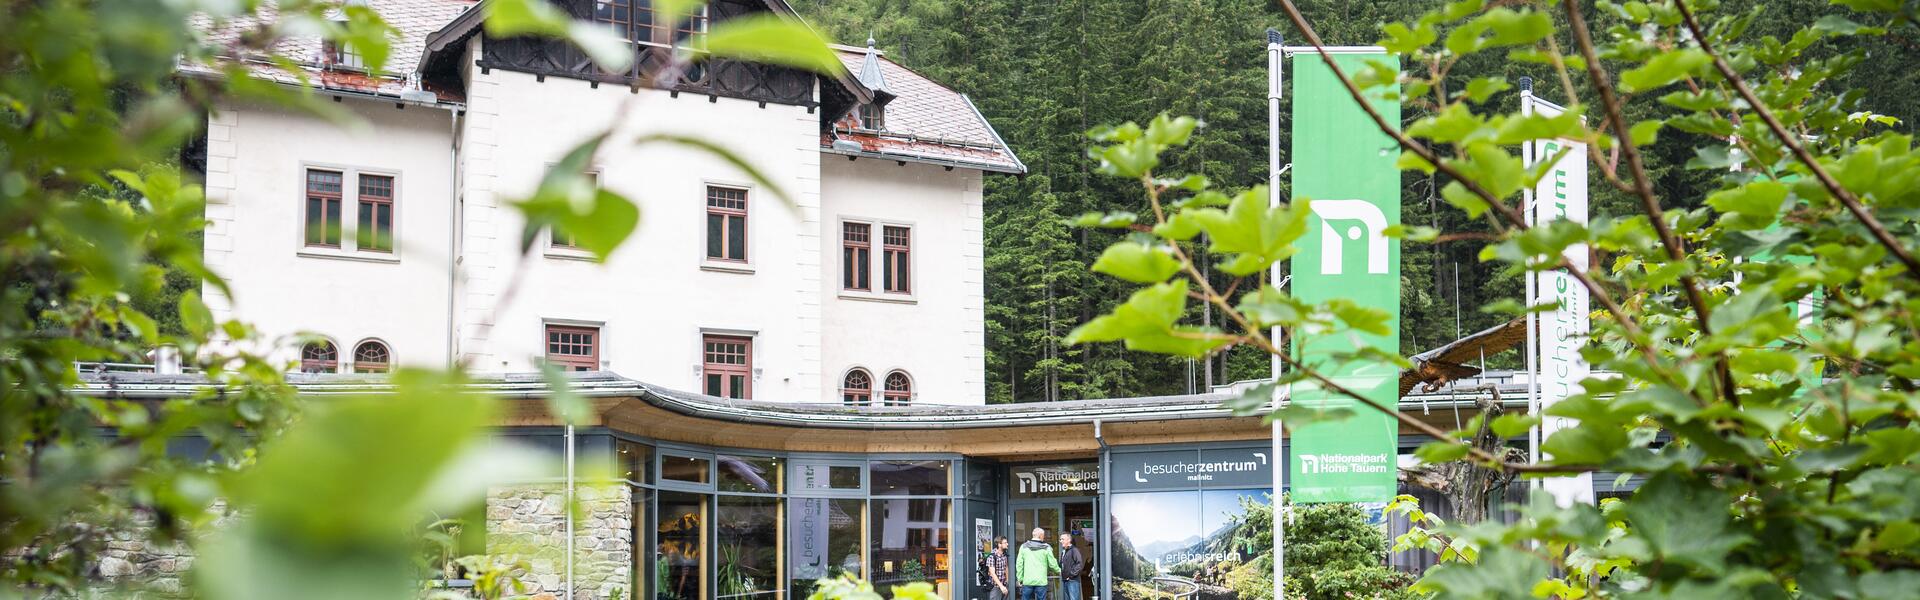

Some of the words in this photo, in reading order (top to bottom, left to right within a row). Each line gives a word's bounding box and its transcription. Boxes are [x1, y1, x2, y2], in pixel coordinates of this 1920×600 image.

[1321, 453, 1388, 464] Nationalpark
[1144, 461, 1257, 475] besucherzentrum
[1320, 463, 1348, 473] Hohe
[1350, 463, 1387, 473] Tauern
[1040, 482, 1068, 492] Hohe
[1166, 550, 1241, 562] erlebnisreich
